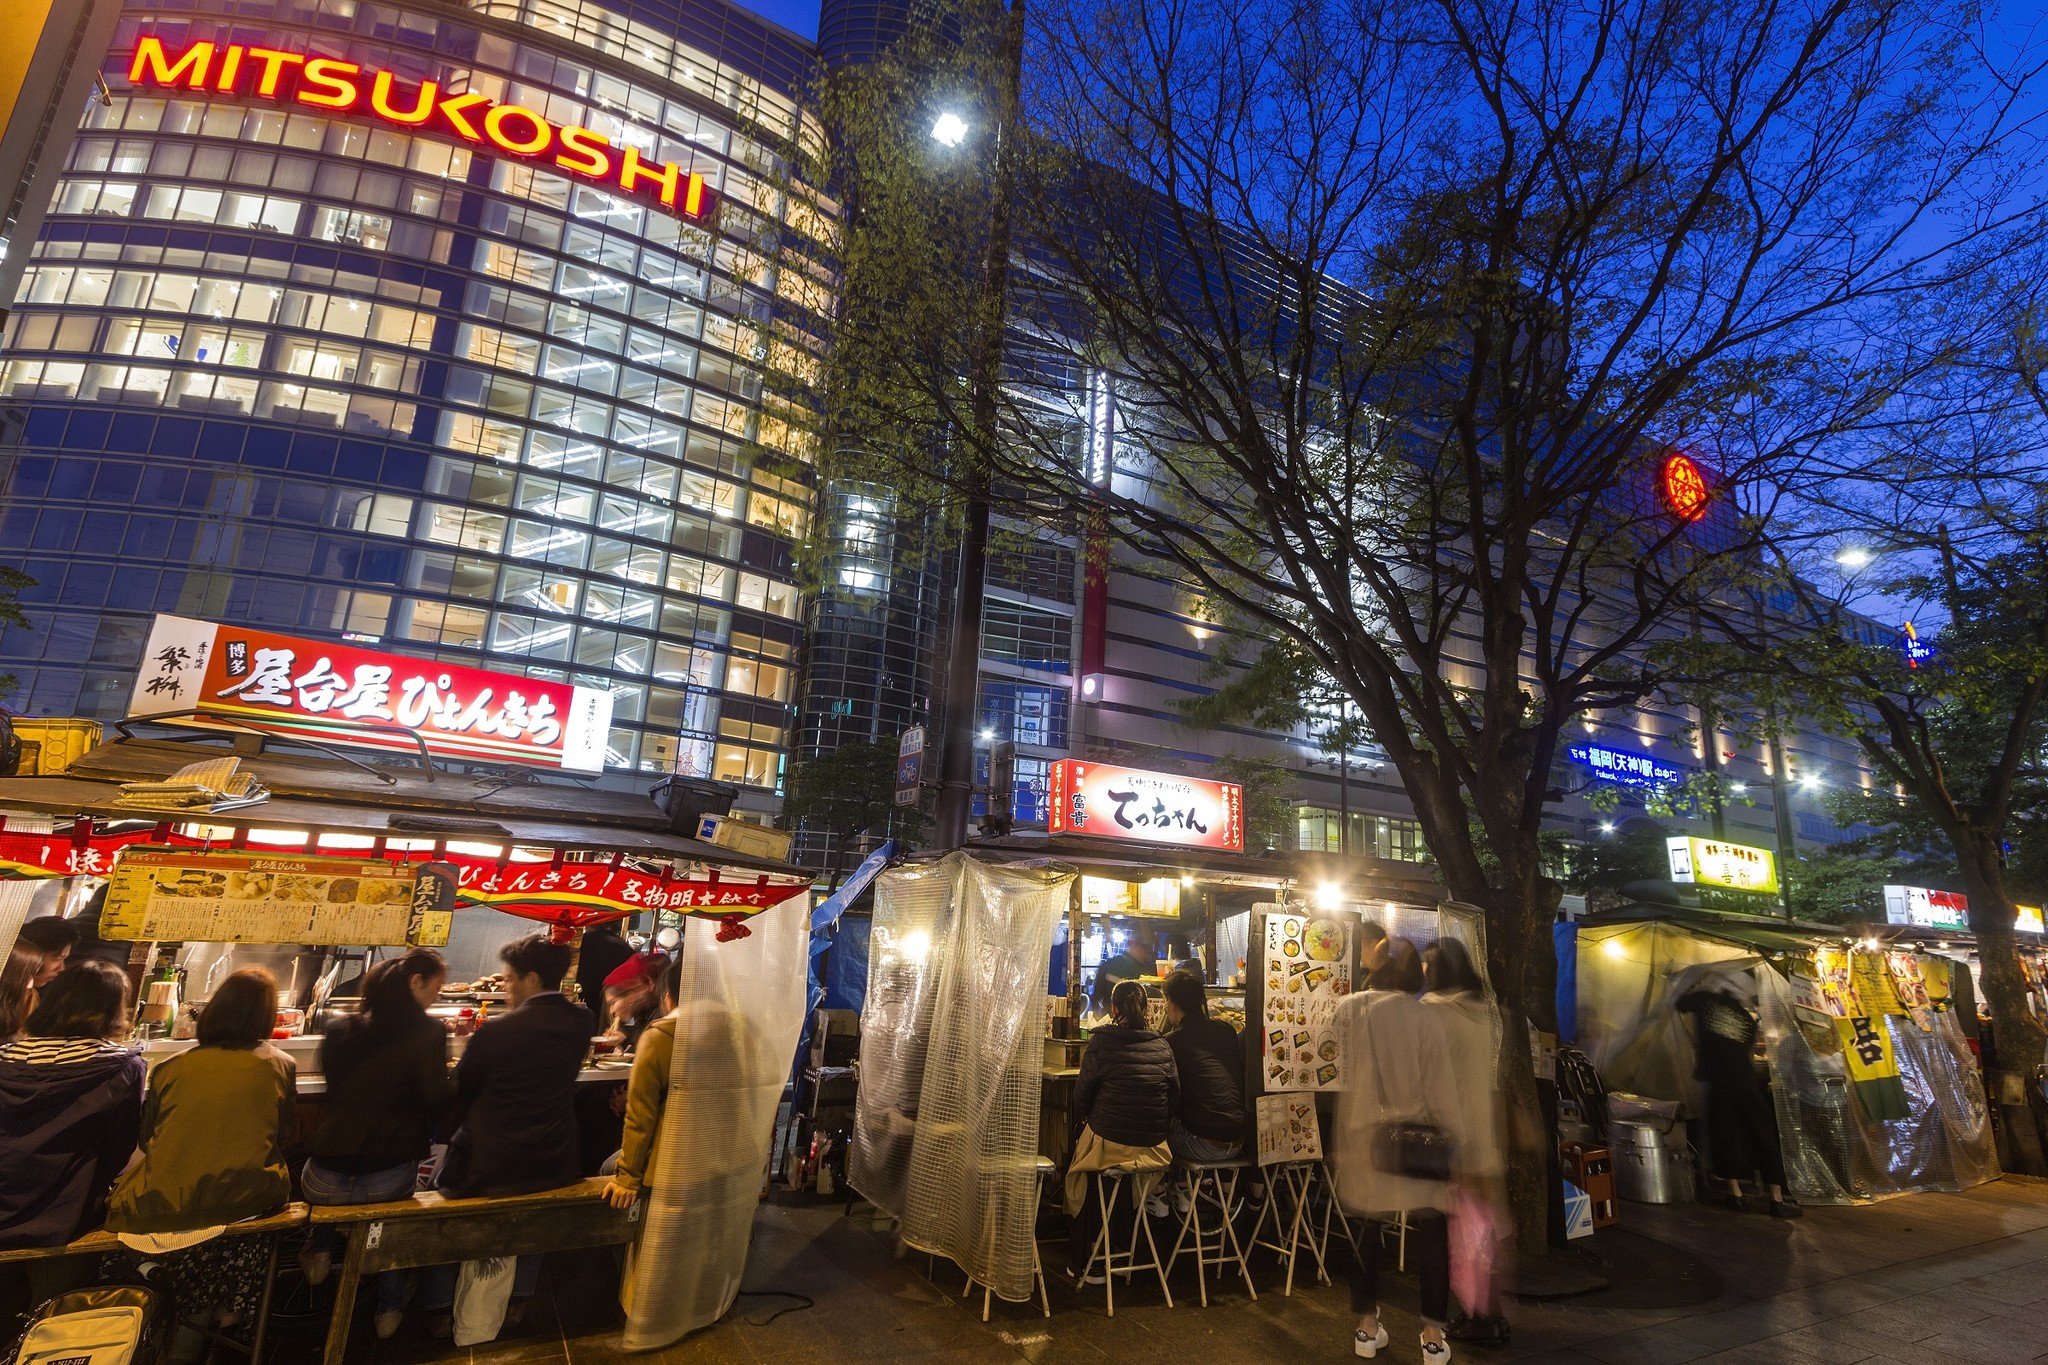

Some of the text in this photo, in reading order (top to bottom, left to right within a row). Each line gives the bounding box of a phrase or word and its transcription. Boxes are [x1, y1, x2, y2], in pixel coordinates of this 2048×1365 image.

[129, 36, 705, 218] MITSUKOSHI
[227, 642, 247, 676] 博多
[217, 647, 562, 746] 屋台屋ぴょんきち
[1070, 793, 1089, 828] 富貴
[1107, 789, 1208, 835] てっちゃん
